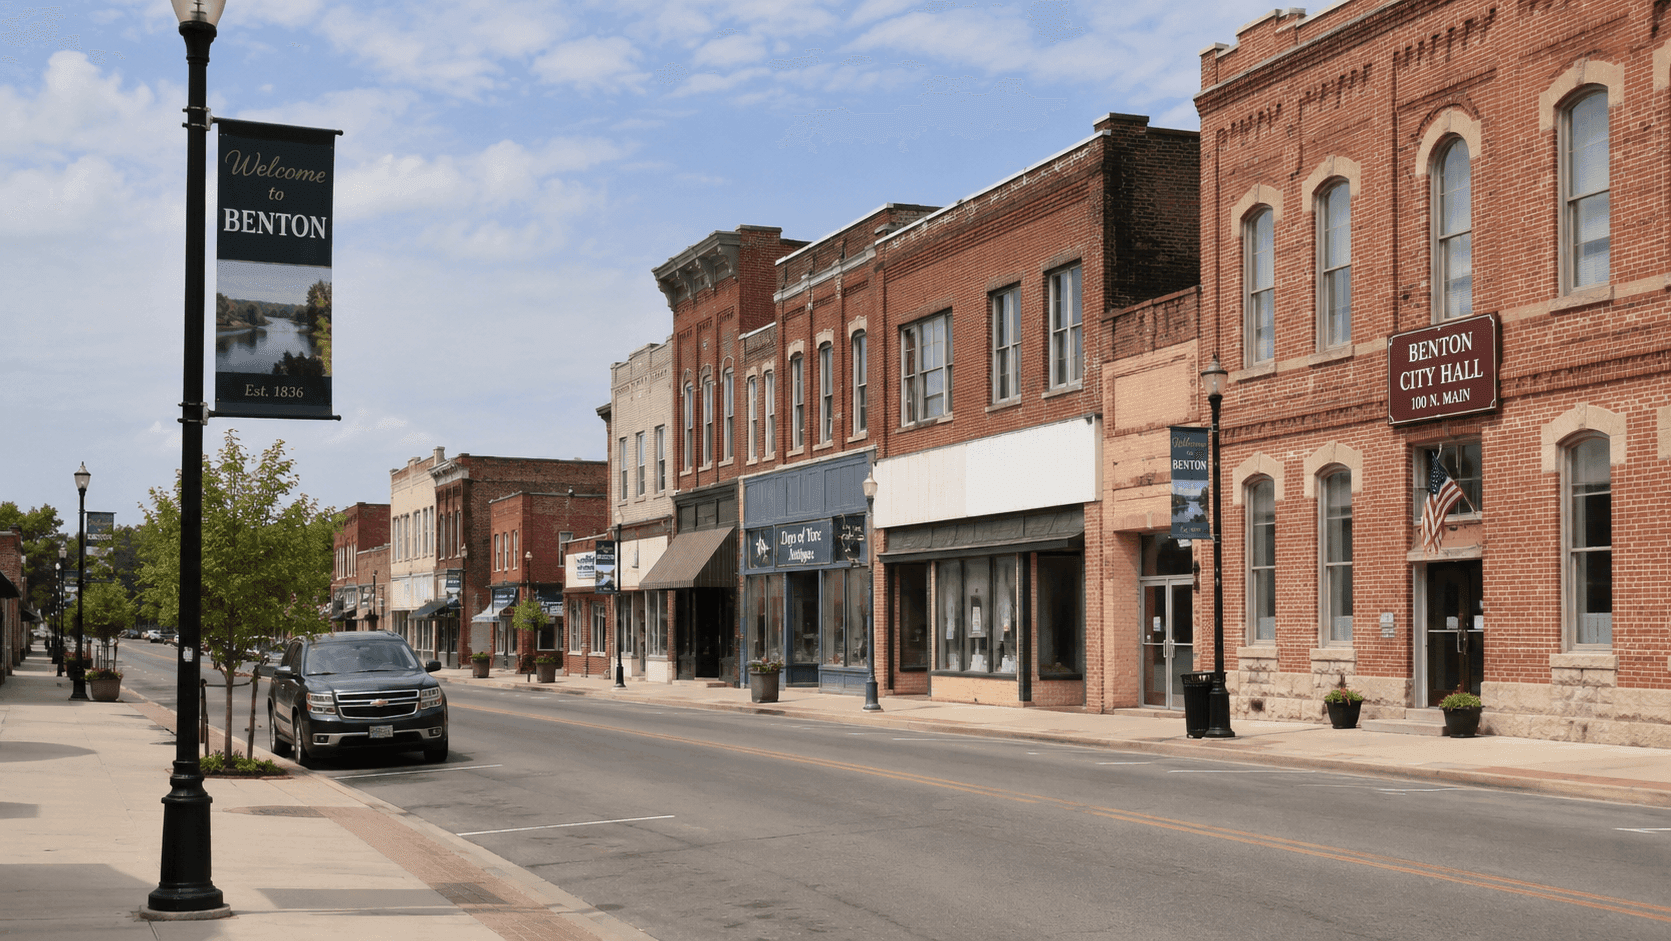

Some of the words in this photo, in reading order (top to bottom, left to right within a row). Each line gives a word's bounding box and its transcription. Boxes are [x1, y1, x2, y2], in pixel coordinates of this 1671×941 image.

[225, 149, 326, 184] Welcome
[268, 186, 285, 201] to
[223, 207, 327, 240] BENTON
[1408, 331, 1473, 363] BENTON
[1400, 366, 1436, 392] CITY
[1440, 358, 1484, 385] HALL
[244, 383, 269, 397] Est.
[273, 385, 304, 399] 1836
[1411, 395, 1427, 411] 100
[1429, 393, 1440, 408] N.
[1442, 388, 1471, 406] MAIN
[1172, 459, 1207, 471] BENTON
